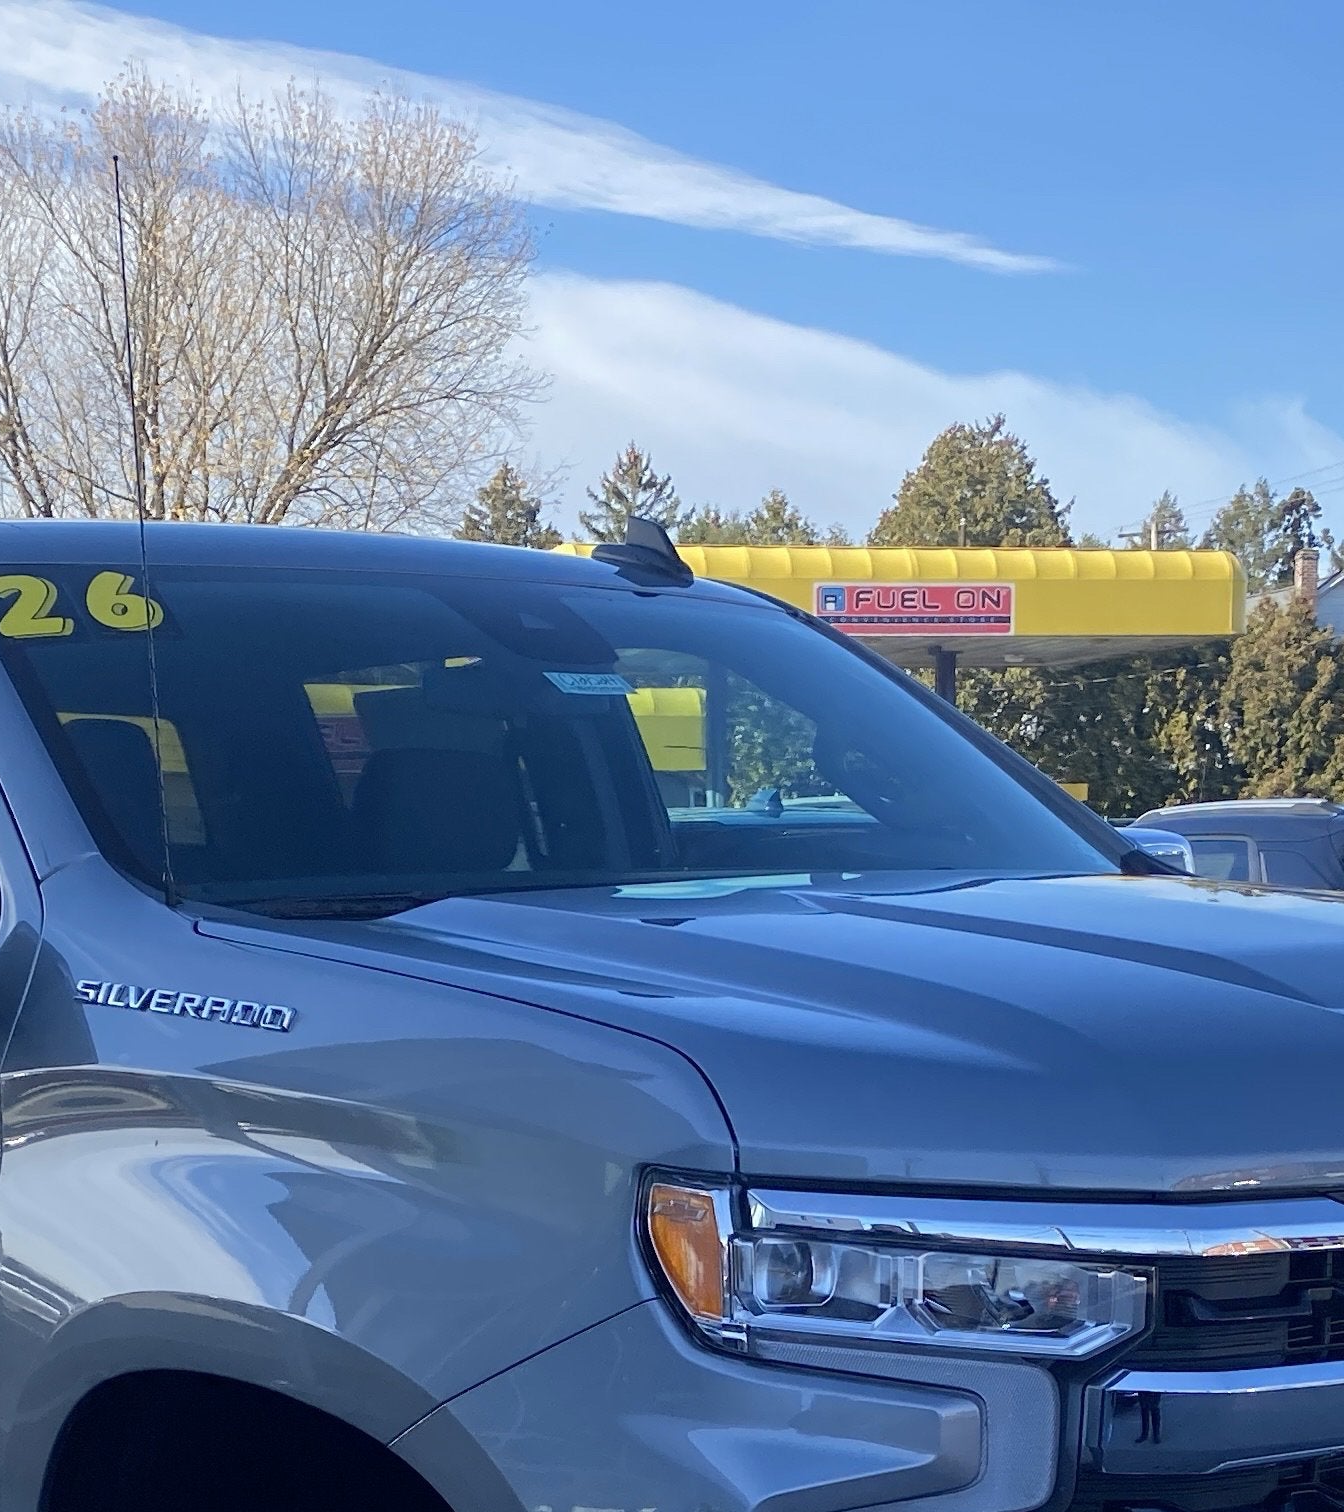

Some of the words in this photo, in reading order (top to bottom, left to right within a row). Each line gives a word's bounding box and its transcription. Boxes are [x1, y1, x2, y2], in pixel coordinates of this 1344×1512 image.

[854, 589, 941, 610] FUEL
[955, 589, 1002, 610] ON
[75, 979, 298, 1033] SILVERADO
